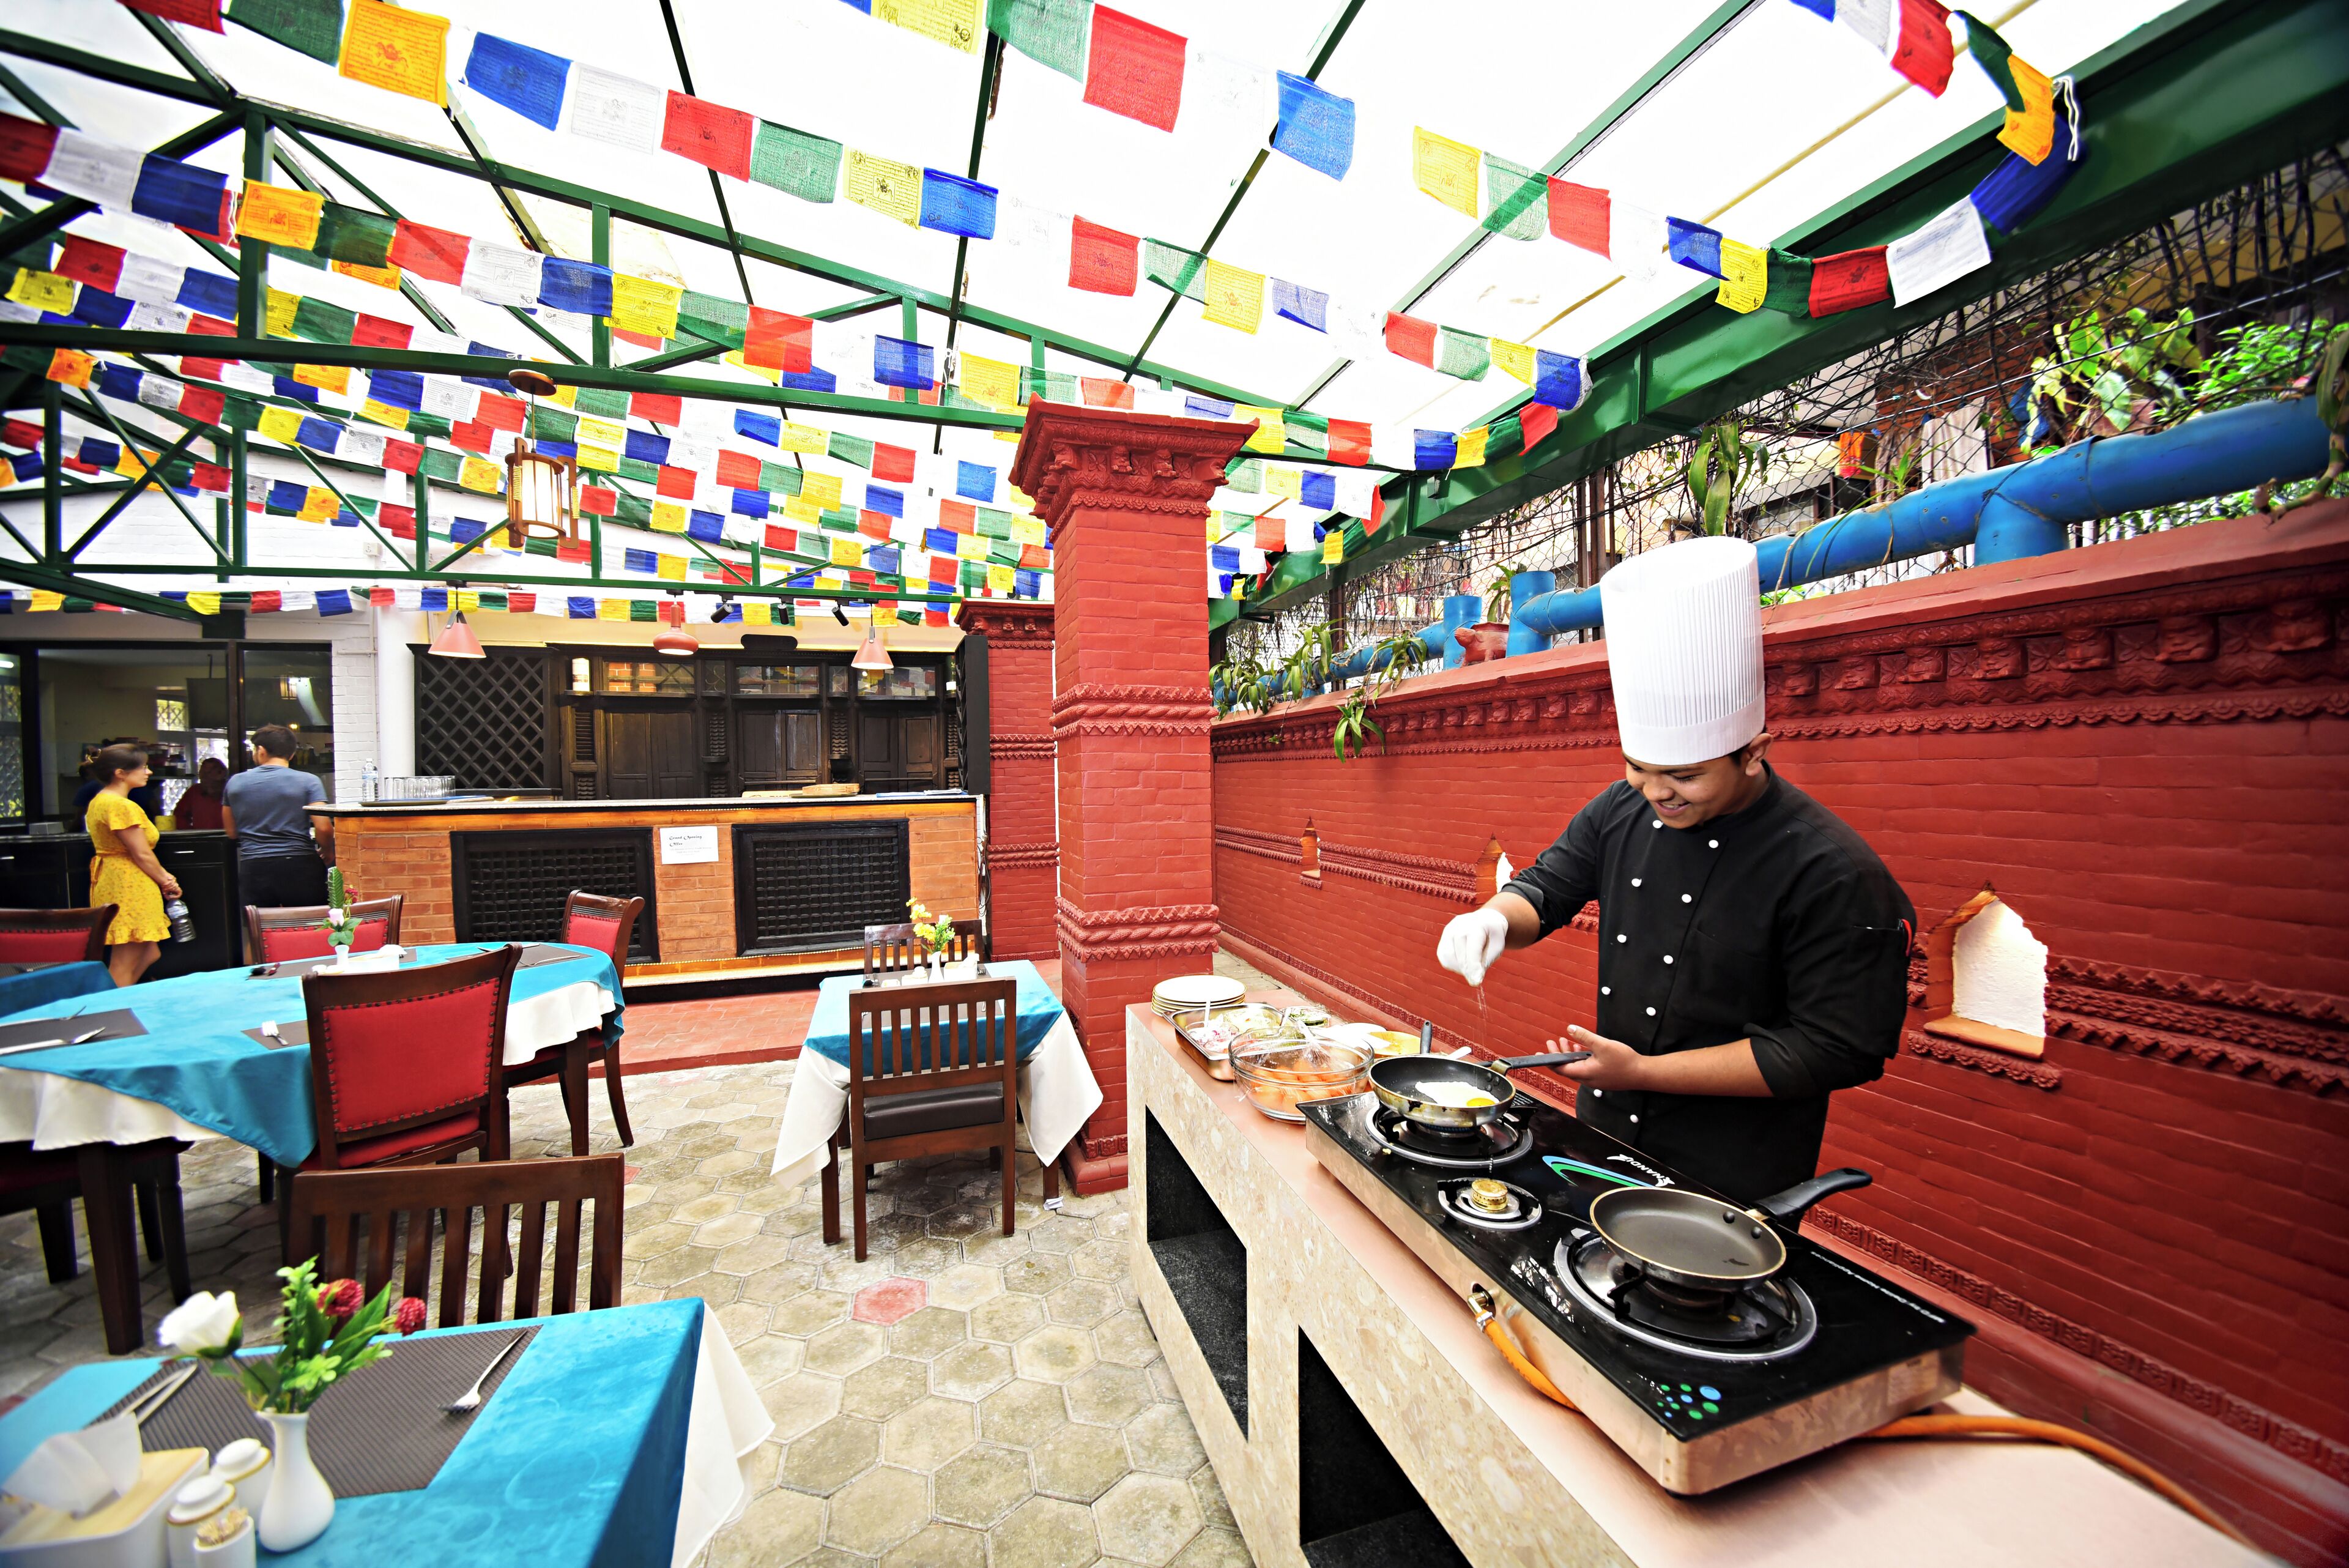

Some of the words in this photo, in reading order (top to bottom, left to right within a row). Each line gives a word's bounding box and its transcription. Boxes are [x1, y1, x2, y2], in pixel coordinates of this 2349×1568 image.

[1810, 1250, 1855, 1275] Appliances
[1854, 1274, 1880, 1289] Home
[1880, 1288, 1908, 1303] Delite
